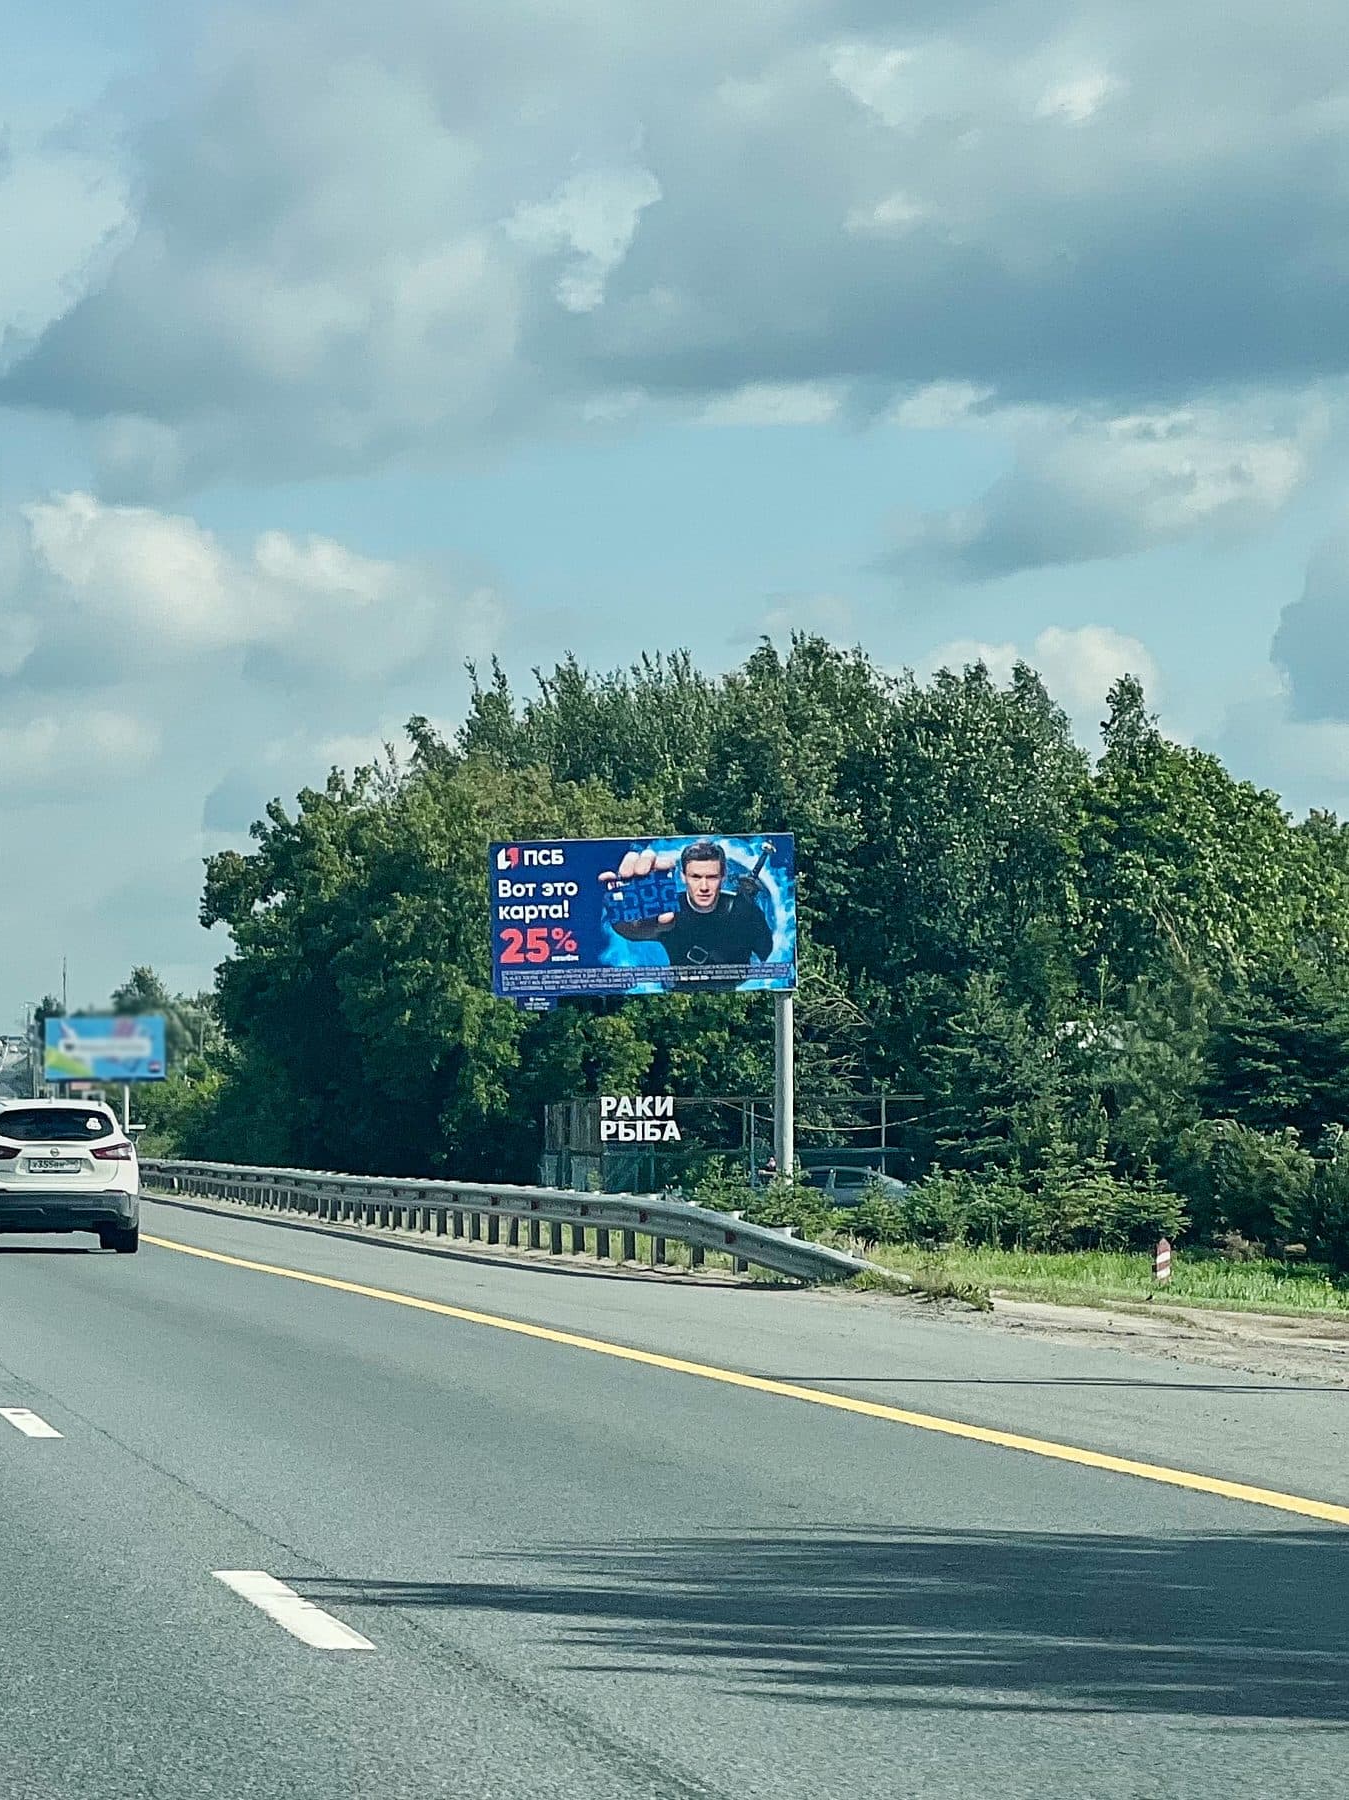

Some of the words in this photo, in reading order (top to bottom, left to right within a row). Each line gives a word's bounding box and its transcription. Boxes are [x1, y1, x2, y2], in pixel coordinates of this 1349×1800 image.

[523, 849, 564, 866] ПСБ
[498, 879, 537, 898] Вот
[541, 881, 578, 897] это
[498, 899, 570, 924] карта!
[499, 927, 578, 964] 25%
[600, 1095, 674, 1117] РАКИ
[600, 1119, 682, 1142] РЫБА
